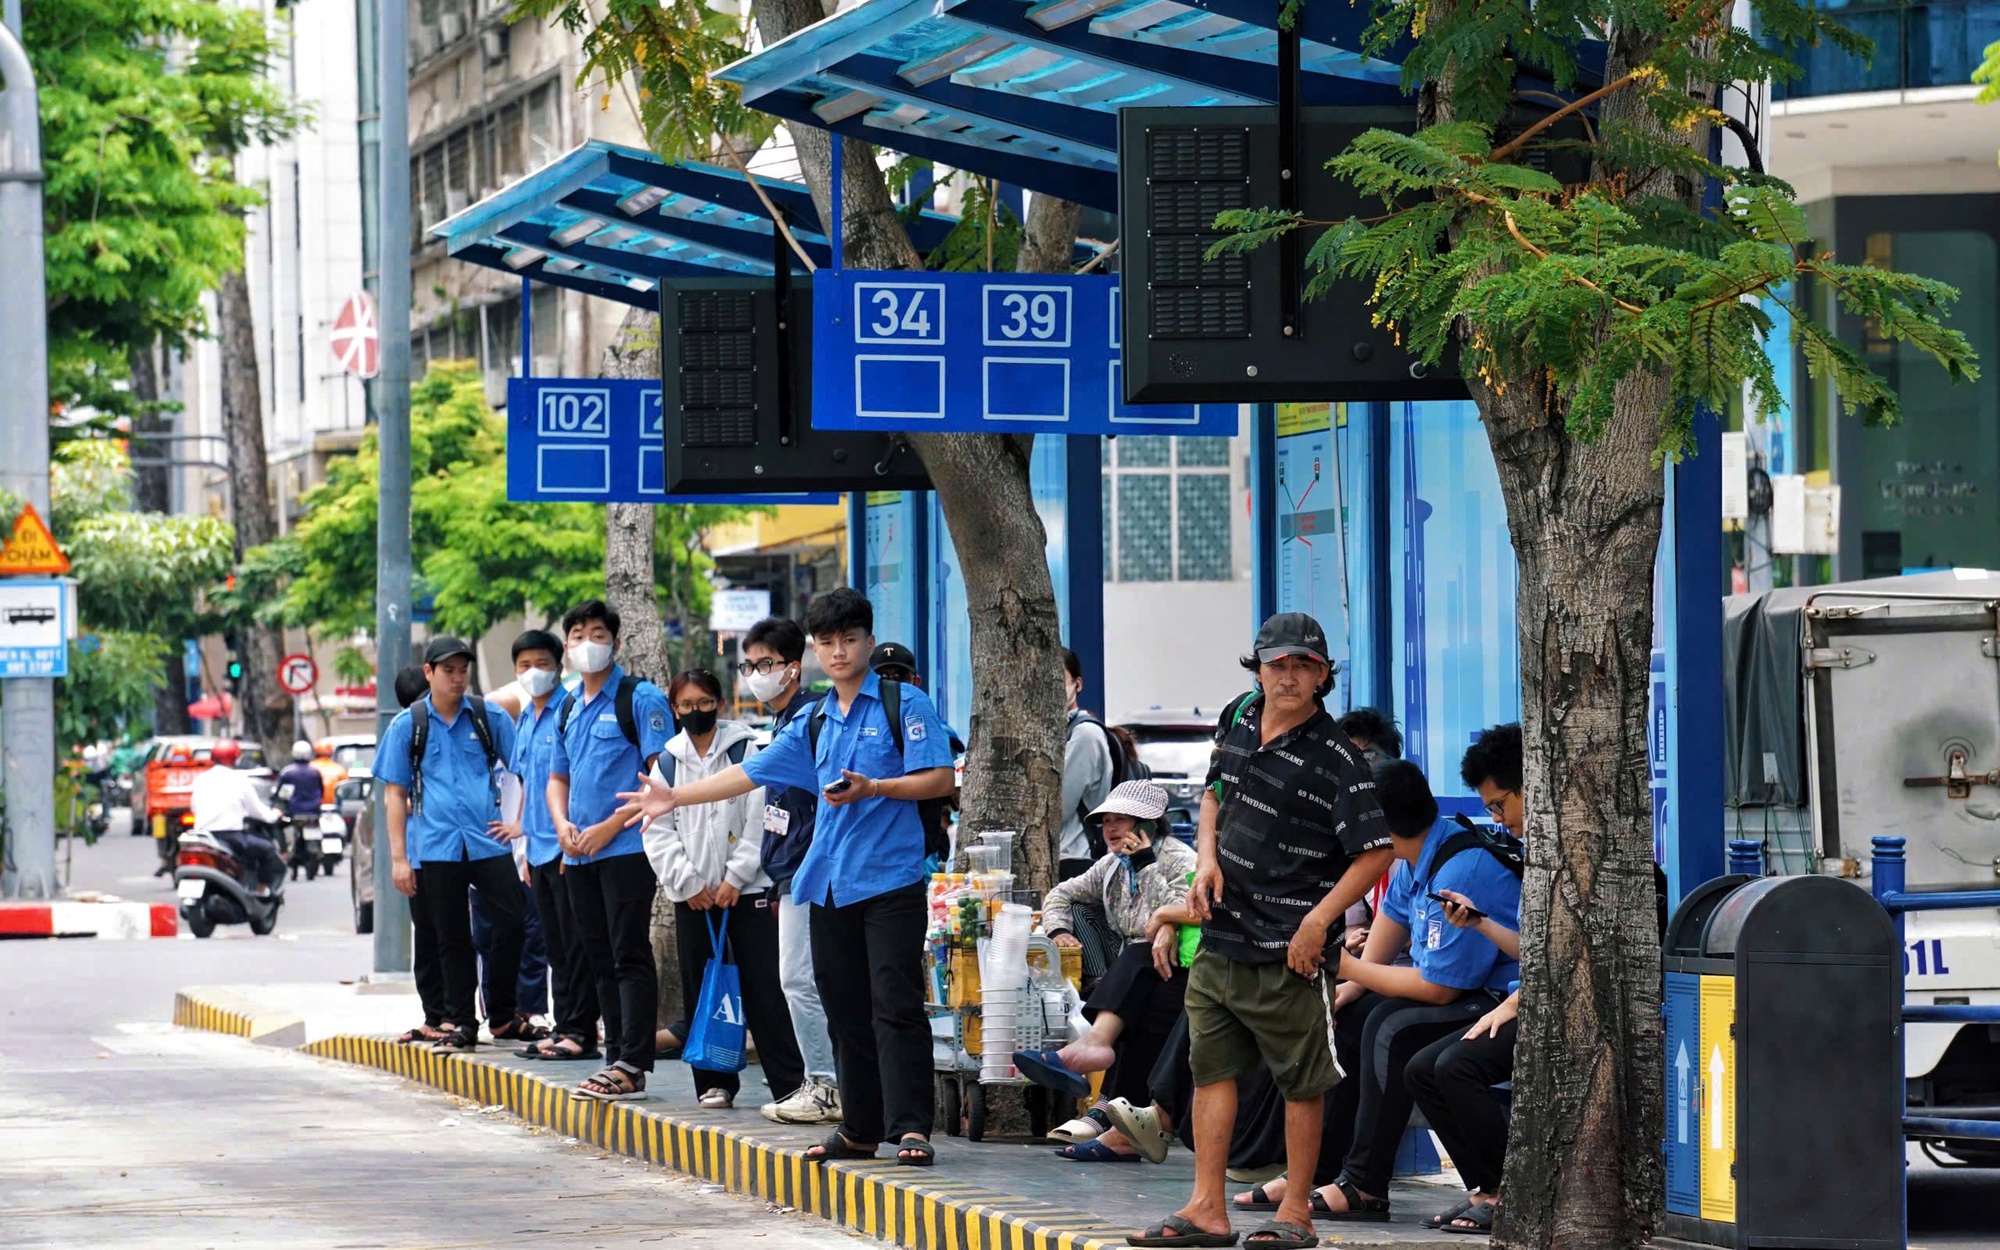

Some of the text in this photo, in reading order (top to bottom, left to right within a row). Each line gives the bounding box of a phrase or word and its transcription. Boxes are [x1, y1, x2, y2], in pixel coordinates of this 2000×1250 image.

[872, 290, 930, 337] 34
[1001, 294, 1056, 339] 39
[544, 394, 604, 431] 102
[883, 647, 894, 657] T
[1325, 739, 1335, 748] 69
[1297, 789, 1308, 798] 69
[1362, 842, 1373, 850] 69
[1253, 892, 1313, 907] 69 DAYDREAMS
